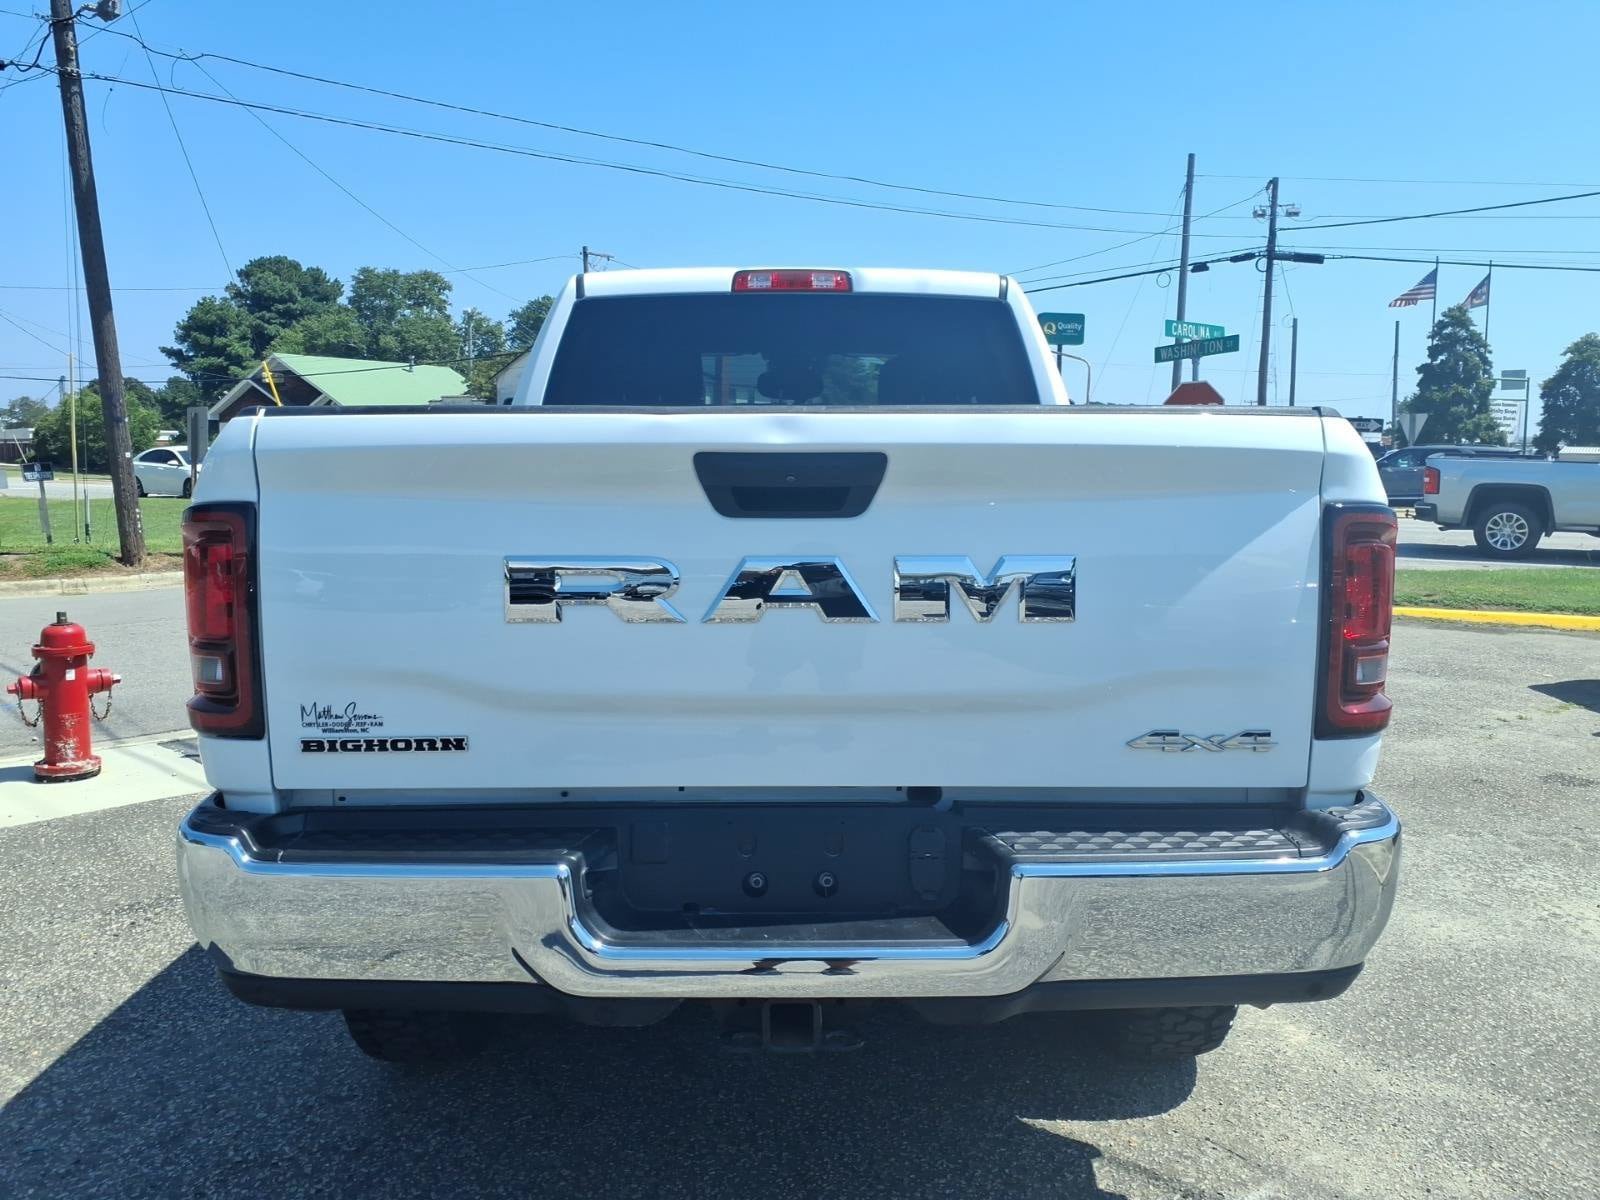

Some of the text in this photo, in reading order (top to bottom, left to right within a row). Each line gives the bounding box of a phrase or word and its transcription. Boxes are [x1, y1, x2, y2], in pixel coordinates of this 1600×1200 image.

[1058, 322, 1082, 331] Quality
[1171, 323, 1210, 339] CAROLINA
[504, 555, 1077, 624] RAM
[301, 737, 468, 752] BIGHORN
